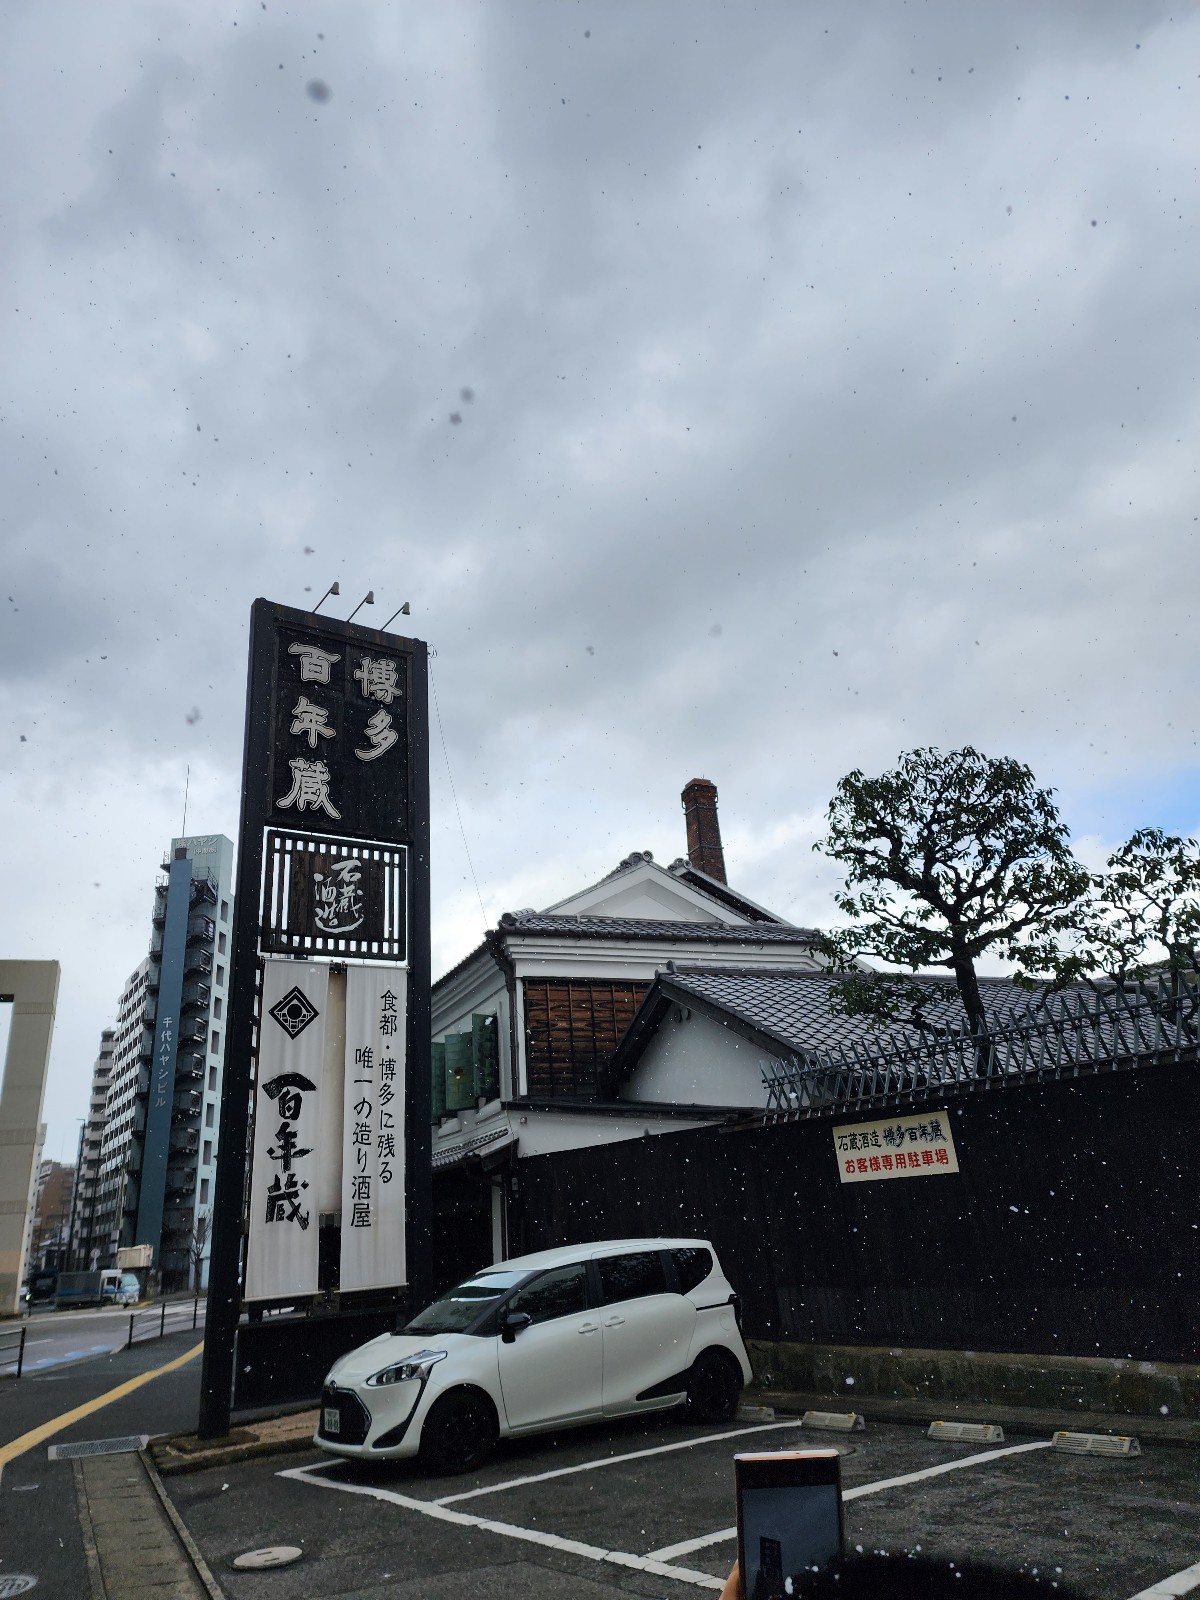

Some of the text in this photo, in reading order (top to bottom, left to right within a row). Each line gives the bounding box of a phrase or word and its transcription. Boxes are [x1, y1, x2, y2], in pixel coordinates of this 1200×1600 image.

[276, 642, 341, 819] 百年蔵
[354, 656, 402, 761] 博多
[155, 1016, 173, 1108] 千代ハヤシビル
[350, 1046, 374, 1228] 唯一の造り酒屋
[377, 989, 398, 1184] 食都・博多に残る
[262, 1072, 317, 1231] 百年蔵
[844, 1148, 950, 1174] お客様専用駐車場
